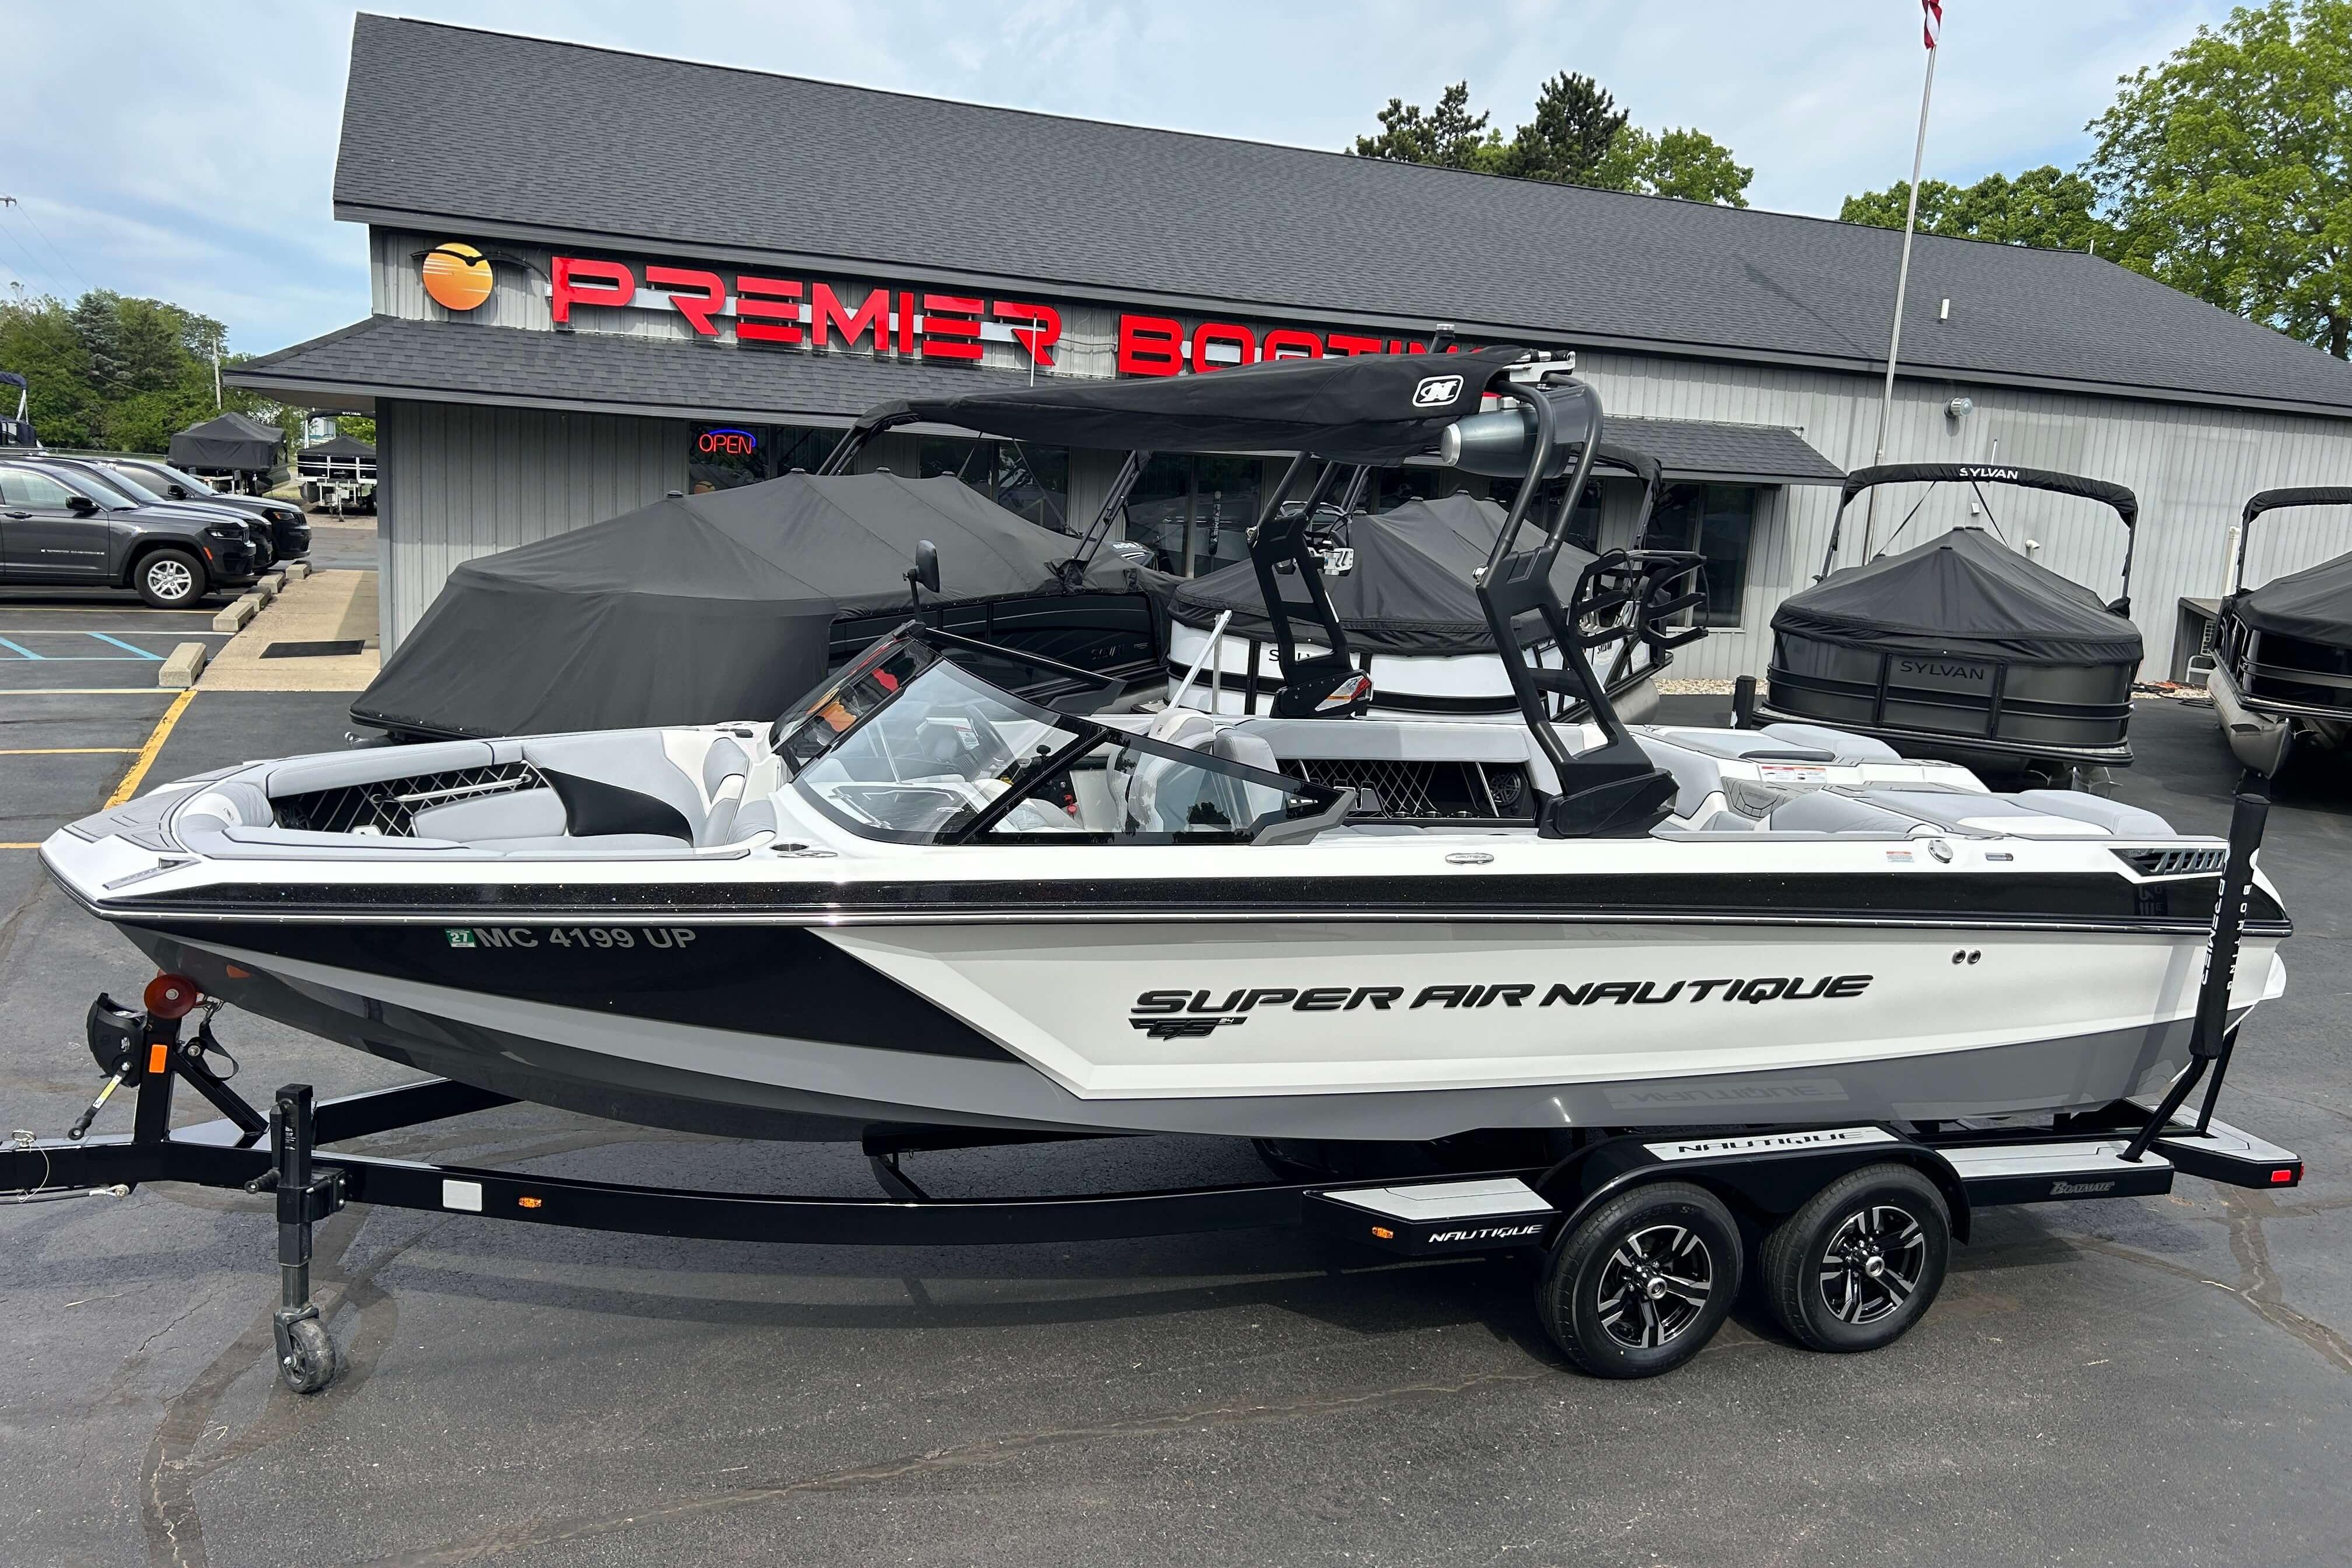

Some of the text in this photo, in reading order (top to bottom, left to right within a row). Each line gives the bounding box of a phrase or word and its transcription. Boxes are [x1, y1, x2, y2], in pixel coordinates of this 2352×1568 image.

[552, 256, 1062, 366] PREMIER
[699, 434, 752, 454] OPEN
[1959, 467, 2018, 480] SYLVAN
[1900, 660, 1984, 680] SYLVAN
[450, 933, 467, 942] 27
[473, 928, 696, 948] MC 4199 UP
[1130, 974, 1874, 1014] SUPER AIR NAUTIQUE
[1678, 1131, 1863, 1153] NAUTIQUE
[1429, 1224, 1544, 1243] NAUTIQUE
